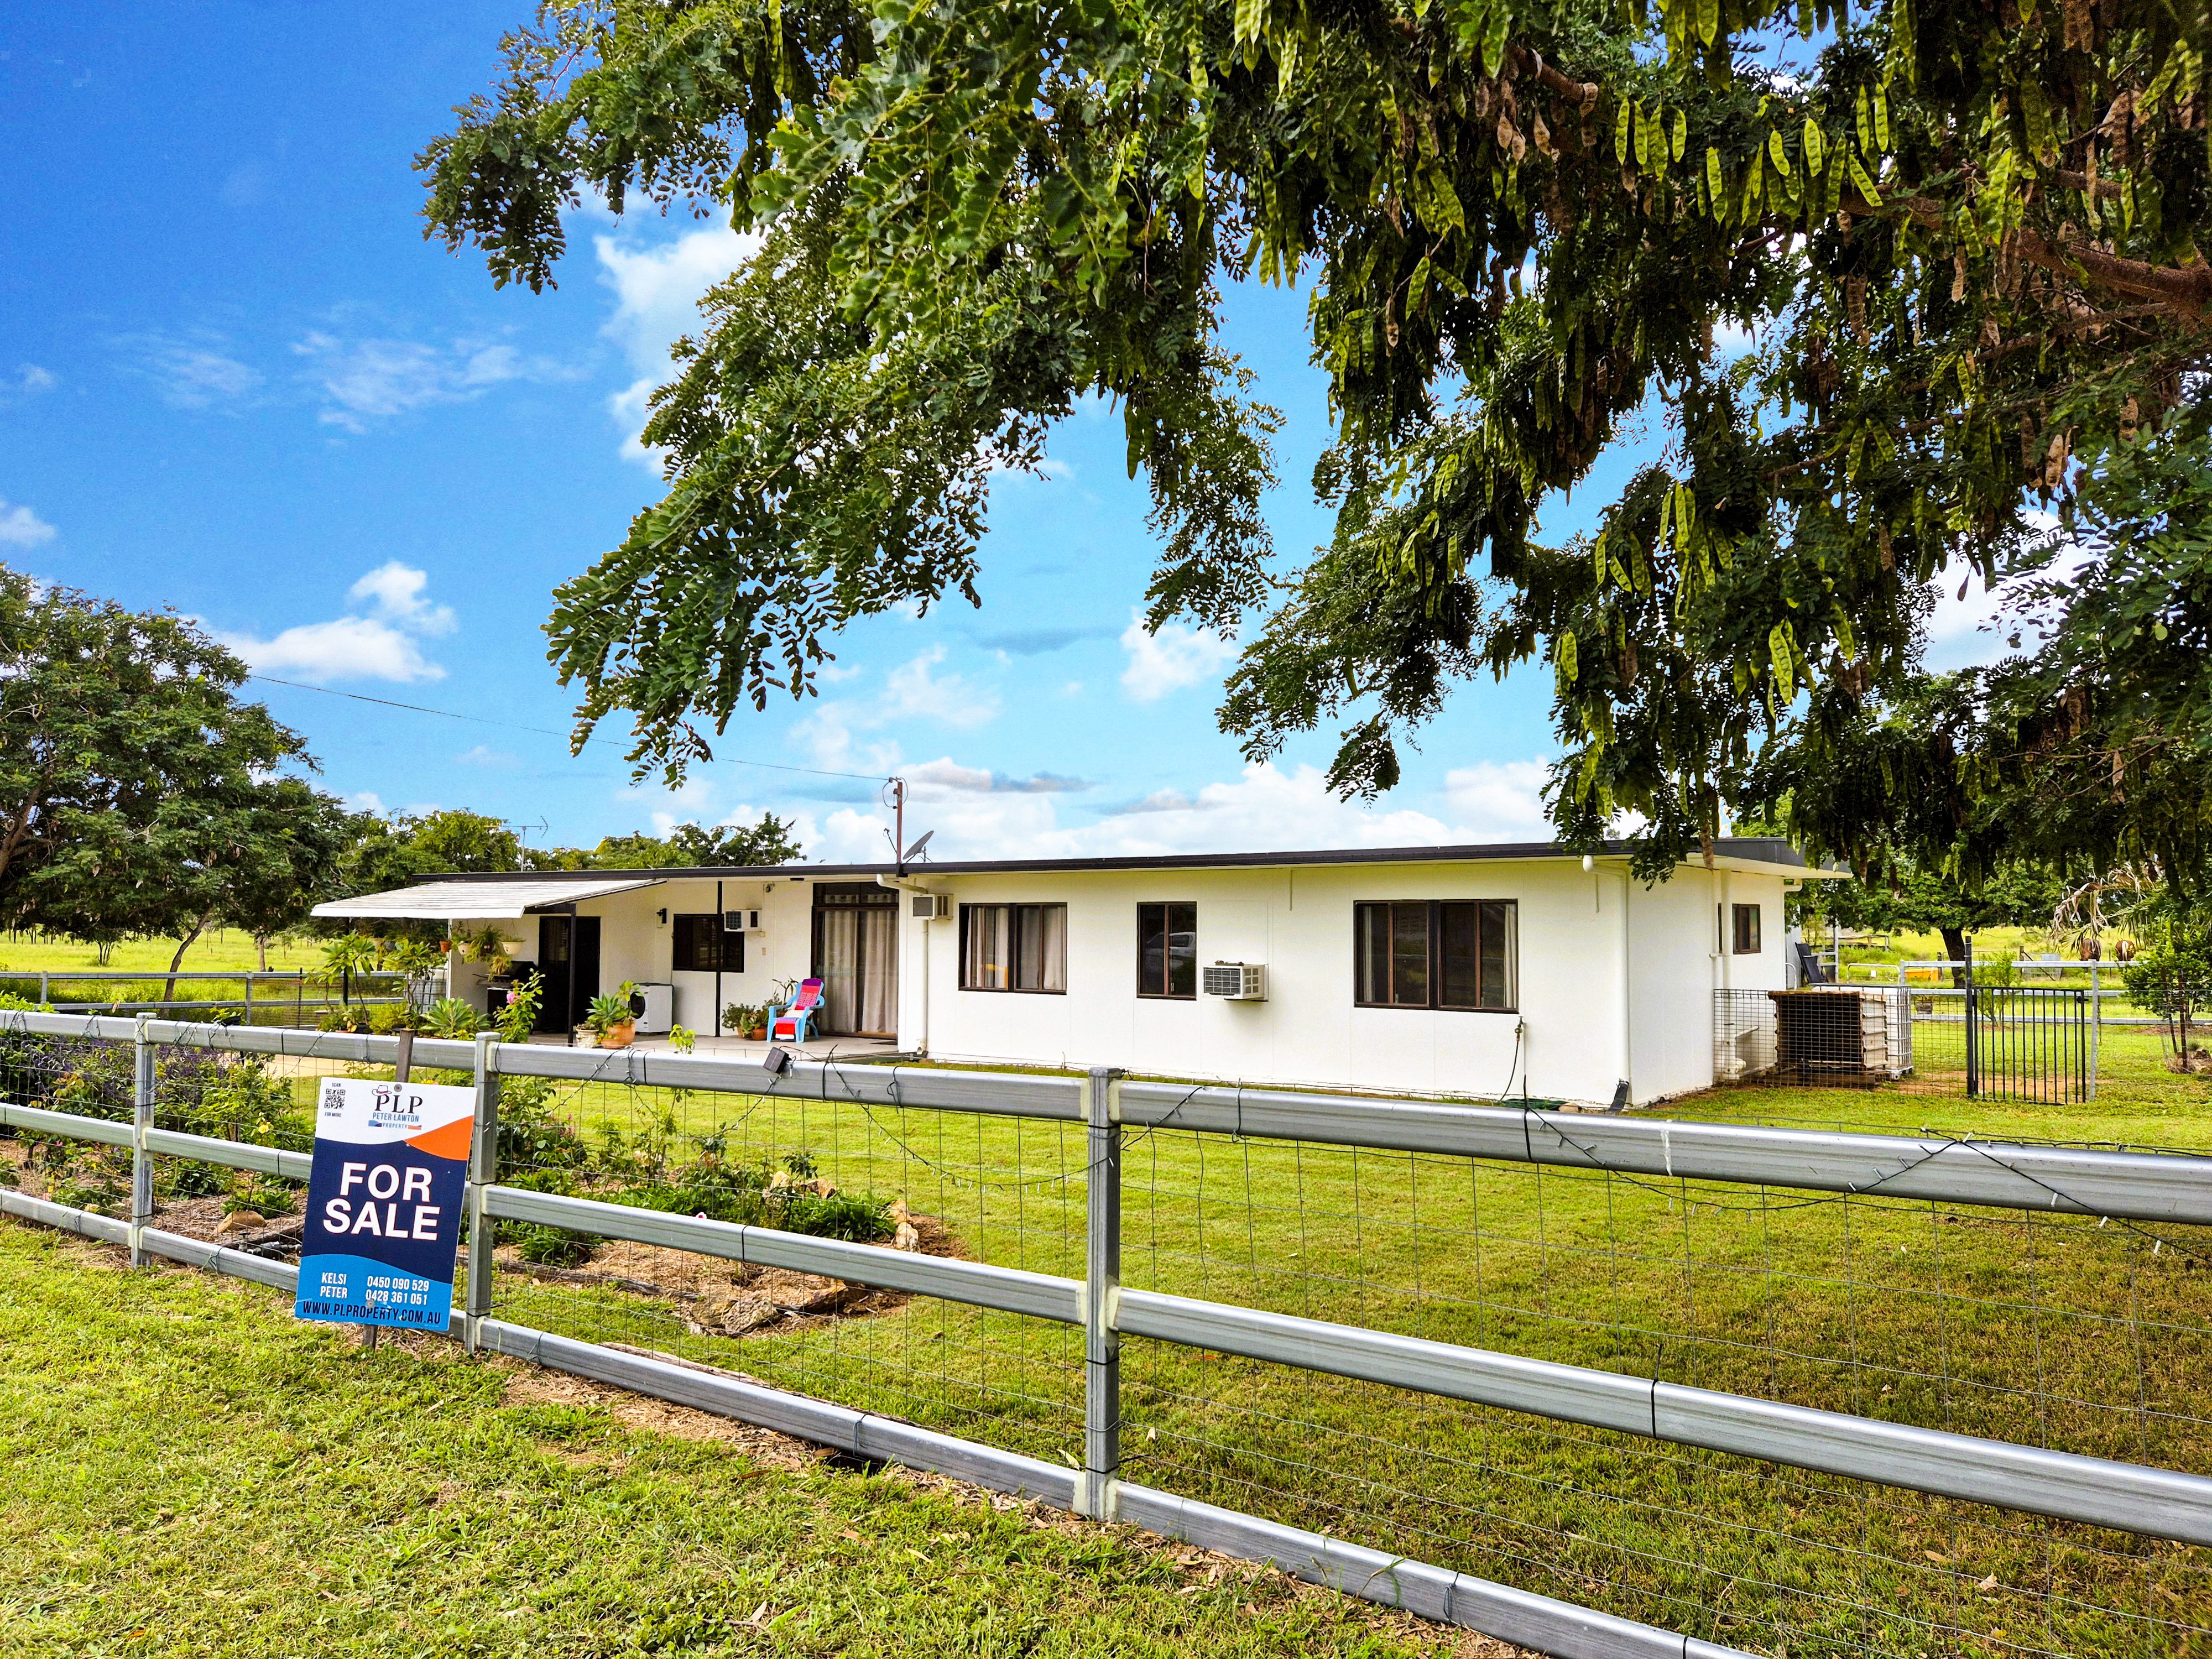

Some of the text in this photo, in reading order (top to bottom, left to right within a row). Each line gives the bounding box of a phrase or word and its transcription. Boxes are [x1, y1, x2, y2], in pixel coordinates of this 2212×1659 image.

[374, 1094, 423, 1114] PLP
[372, 1112, 419, 1123] PETER LAWTON
[340, 1162, 433, 1202] FOR
[323, 1198, 441, 1241] SALE
[321, 1272, 430, 1292] KELSI 0450 090 529
[320, 1286, 427, 1306] PETER 0428 361 051
